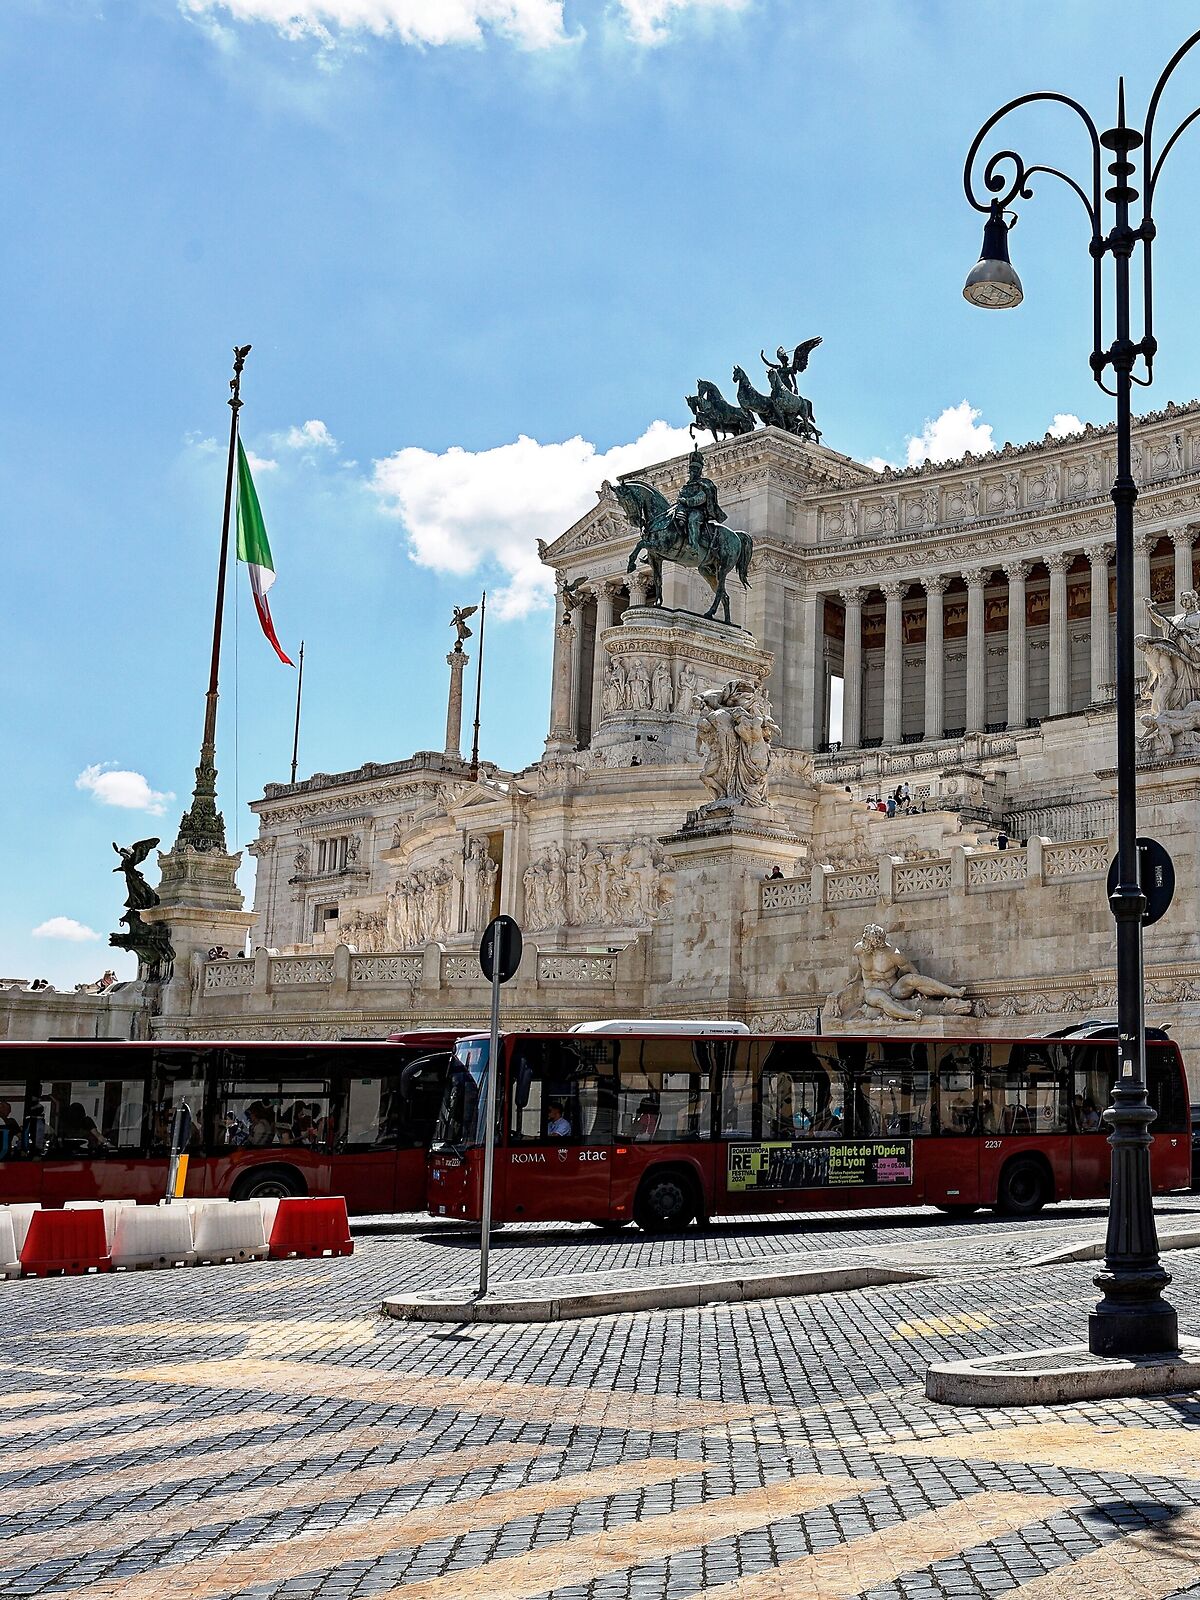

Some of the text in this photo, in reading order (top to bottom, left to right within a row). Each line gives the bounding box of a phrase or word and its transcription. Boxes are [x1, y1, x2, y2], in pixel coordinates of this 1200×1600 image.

[985, 1140, 1002, 1149] 2237
[579, 1150, 607, 1161] atac
[829, 1144, 906, 1158] Ballet de l'Opéra
[511, 1153, 546, 1163] ROMA
[829, 1156, 866, 1169] de Lyon
